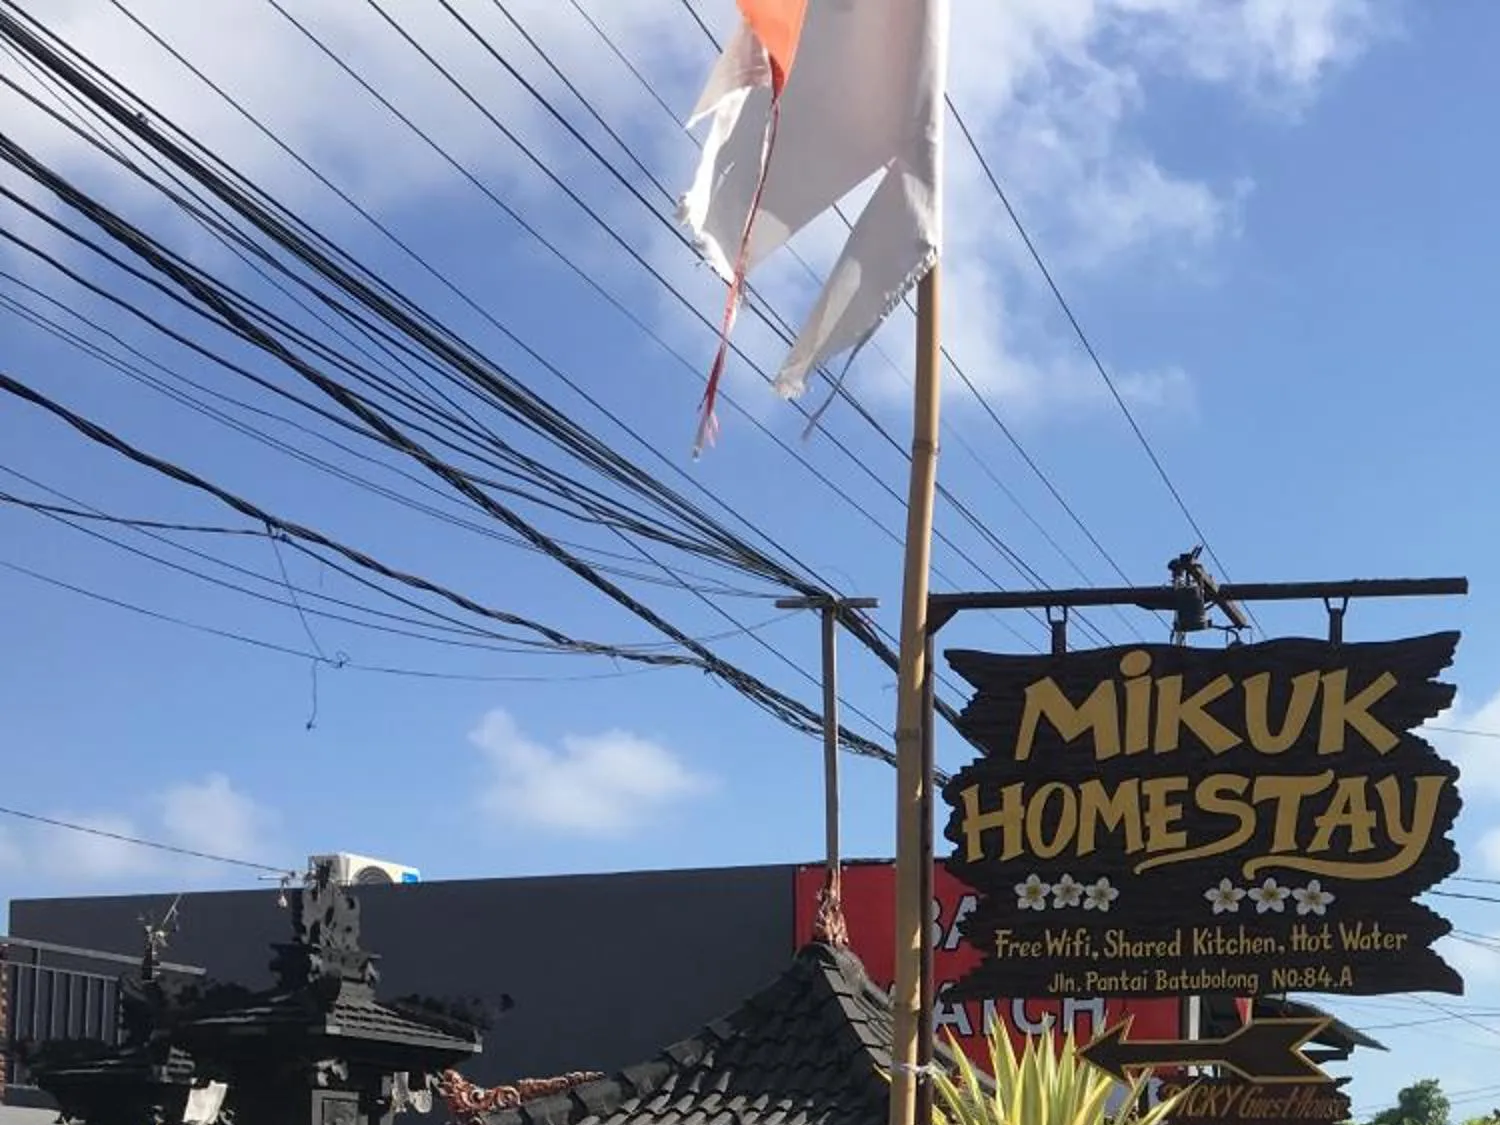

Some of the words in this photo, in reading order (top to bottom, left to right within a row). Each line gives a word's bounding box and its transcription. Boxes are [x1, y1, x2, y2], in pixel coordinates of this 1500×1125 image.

[960, 769, 1448, 881] HOMESTAY
[994, 929, 1043, 959] Free
[1104, 927, 1181, 959] Shared
[1290, 922, 1332, 951] Hot
[1339, 921, 1408, 951] Water
[1047, 971, 1081, 993] Jln.
[1085, 969, 1148, 992] Pantai
[1155, 968, 1259, 994] Batubolong
